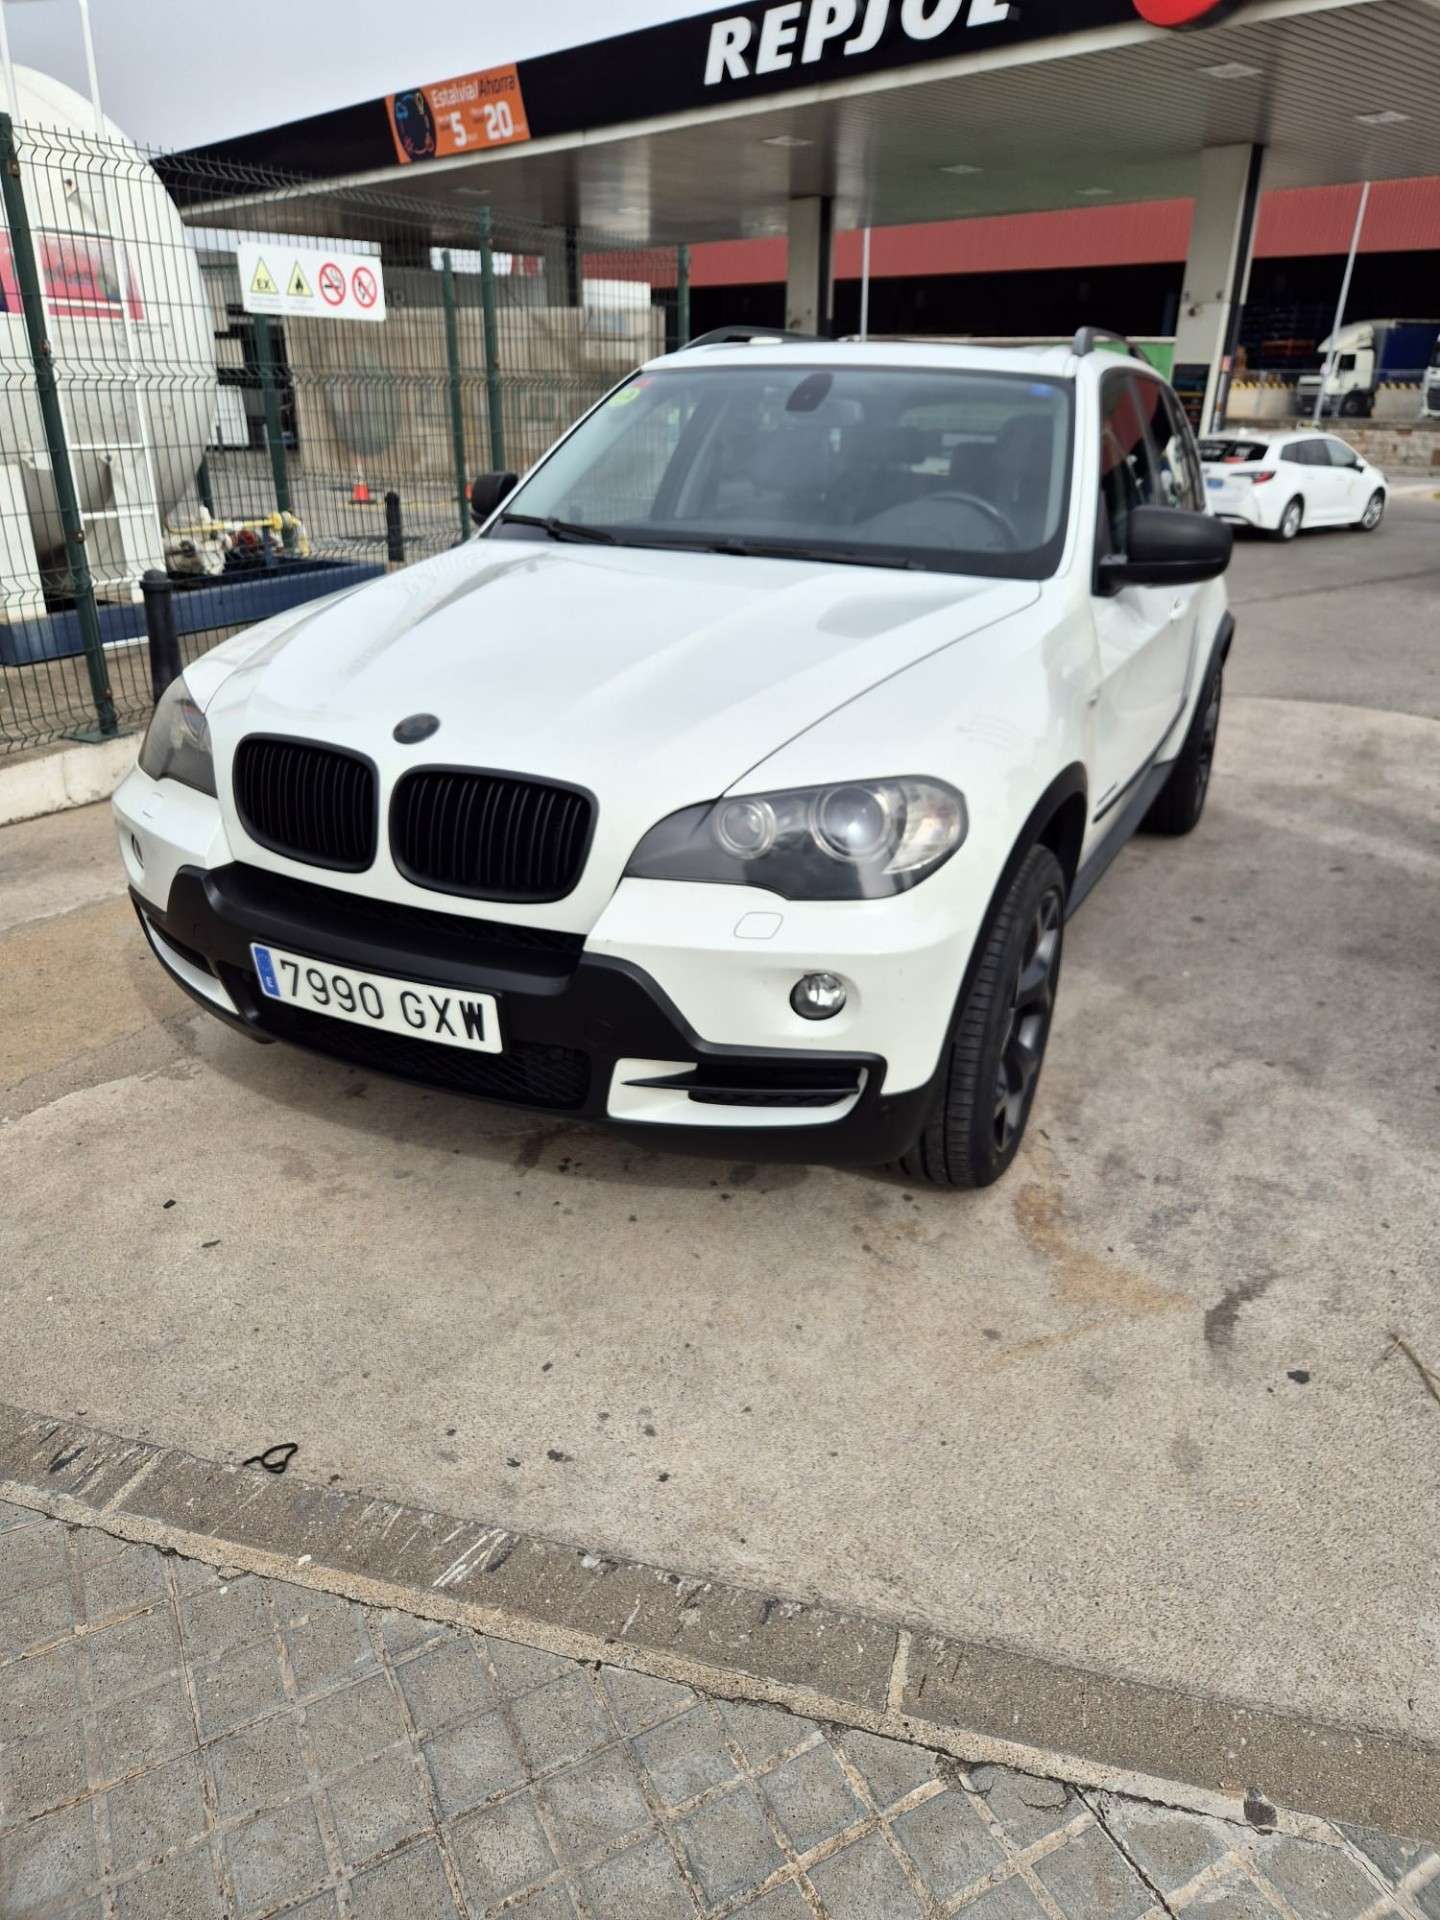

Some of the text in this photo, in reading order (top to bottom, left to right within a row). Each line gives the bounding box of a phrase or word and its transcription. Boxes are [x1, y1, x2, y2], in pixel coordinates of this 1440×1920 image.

[449, 111, 468, 147] 5
[484, 100, 514, 141] 20
[280, 959, 486, 1042] 7990 GXW
